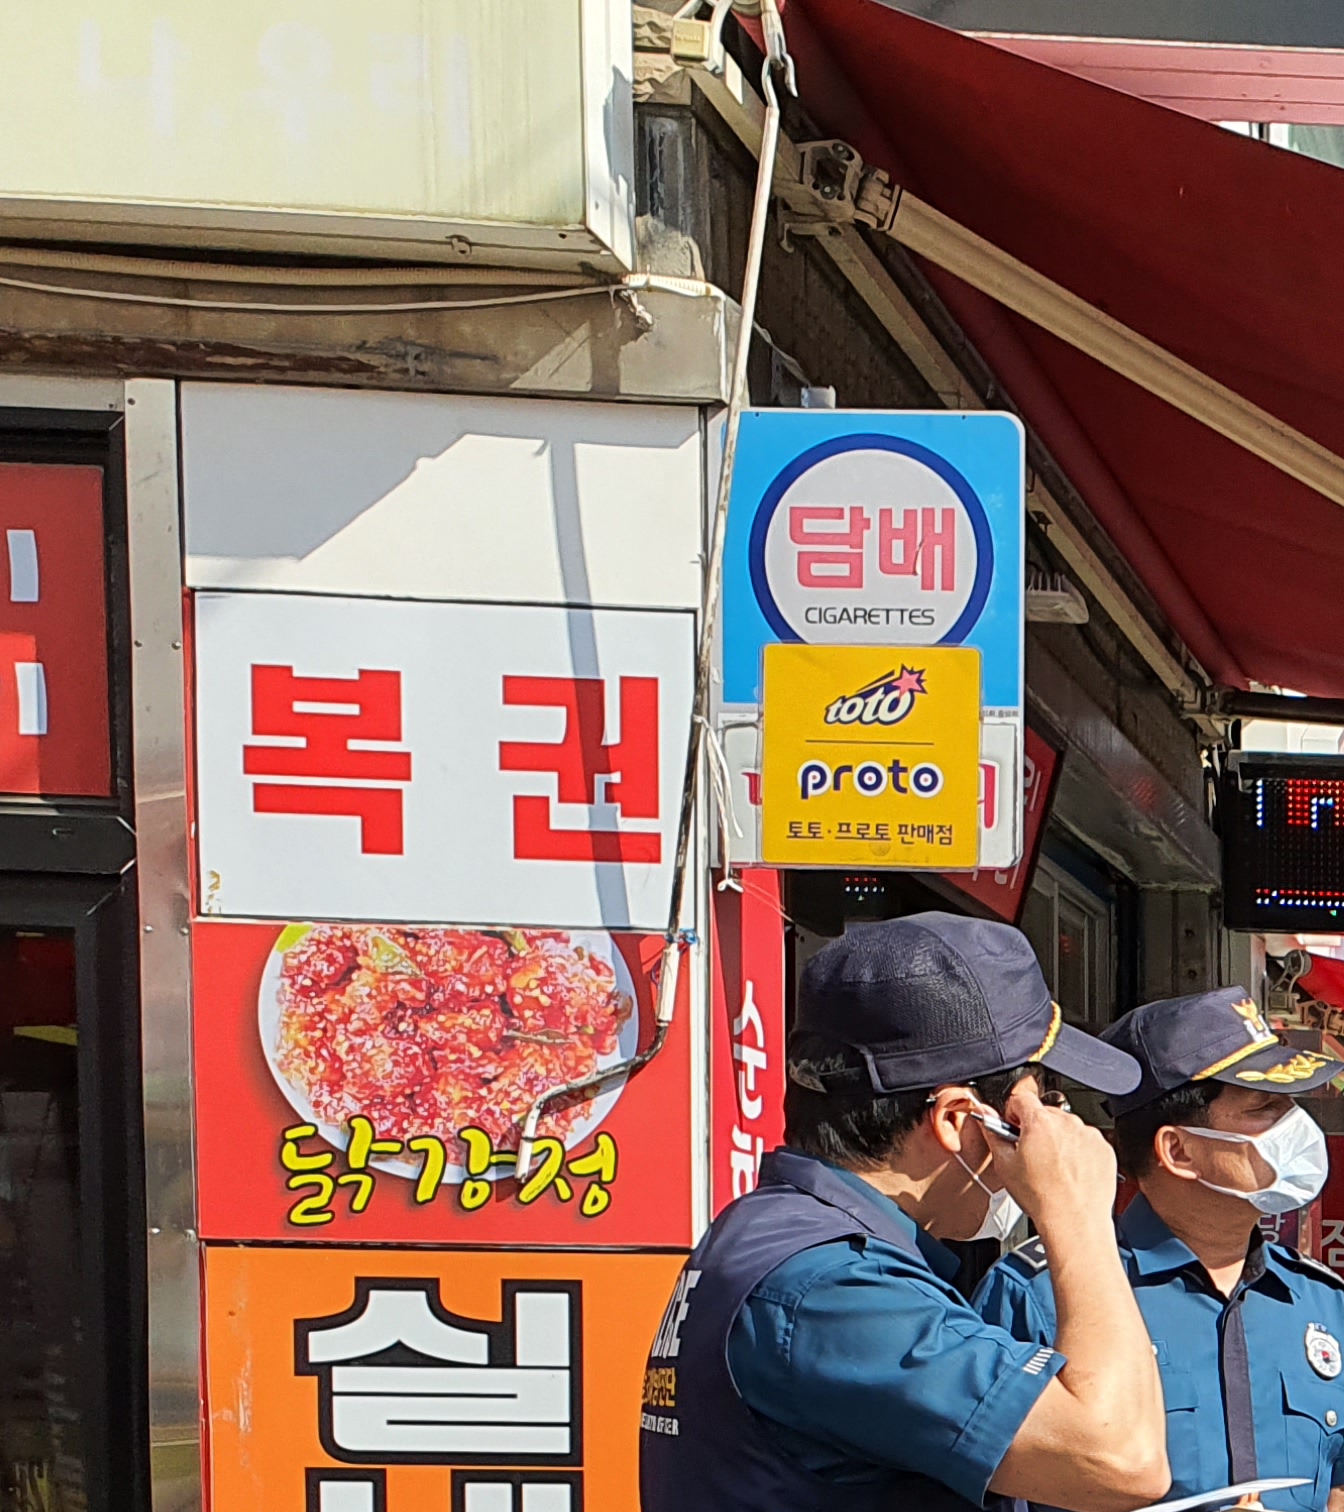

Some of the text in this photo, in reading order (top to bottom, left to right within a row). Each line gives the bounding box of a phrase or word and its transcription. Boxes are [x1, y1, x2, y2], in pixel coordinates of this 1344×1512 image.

[788, 506, 956, 592] 담배
[804, 607, 935, 627] CIGARETTES
[825, 686, 914, 726] toto
[242, 663, 662, 864] 복권
[798, 759, 944, 800] proto
[897, 823, 953, 847] 판매점
[279, 1116, 620, 1228] 닭강정
